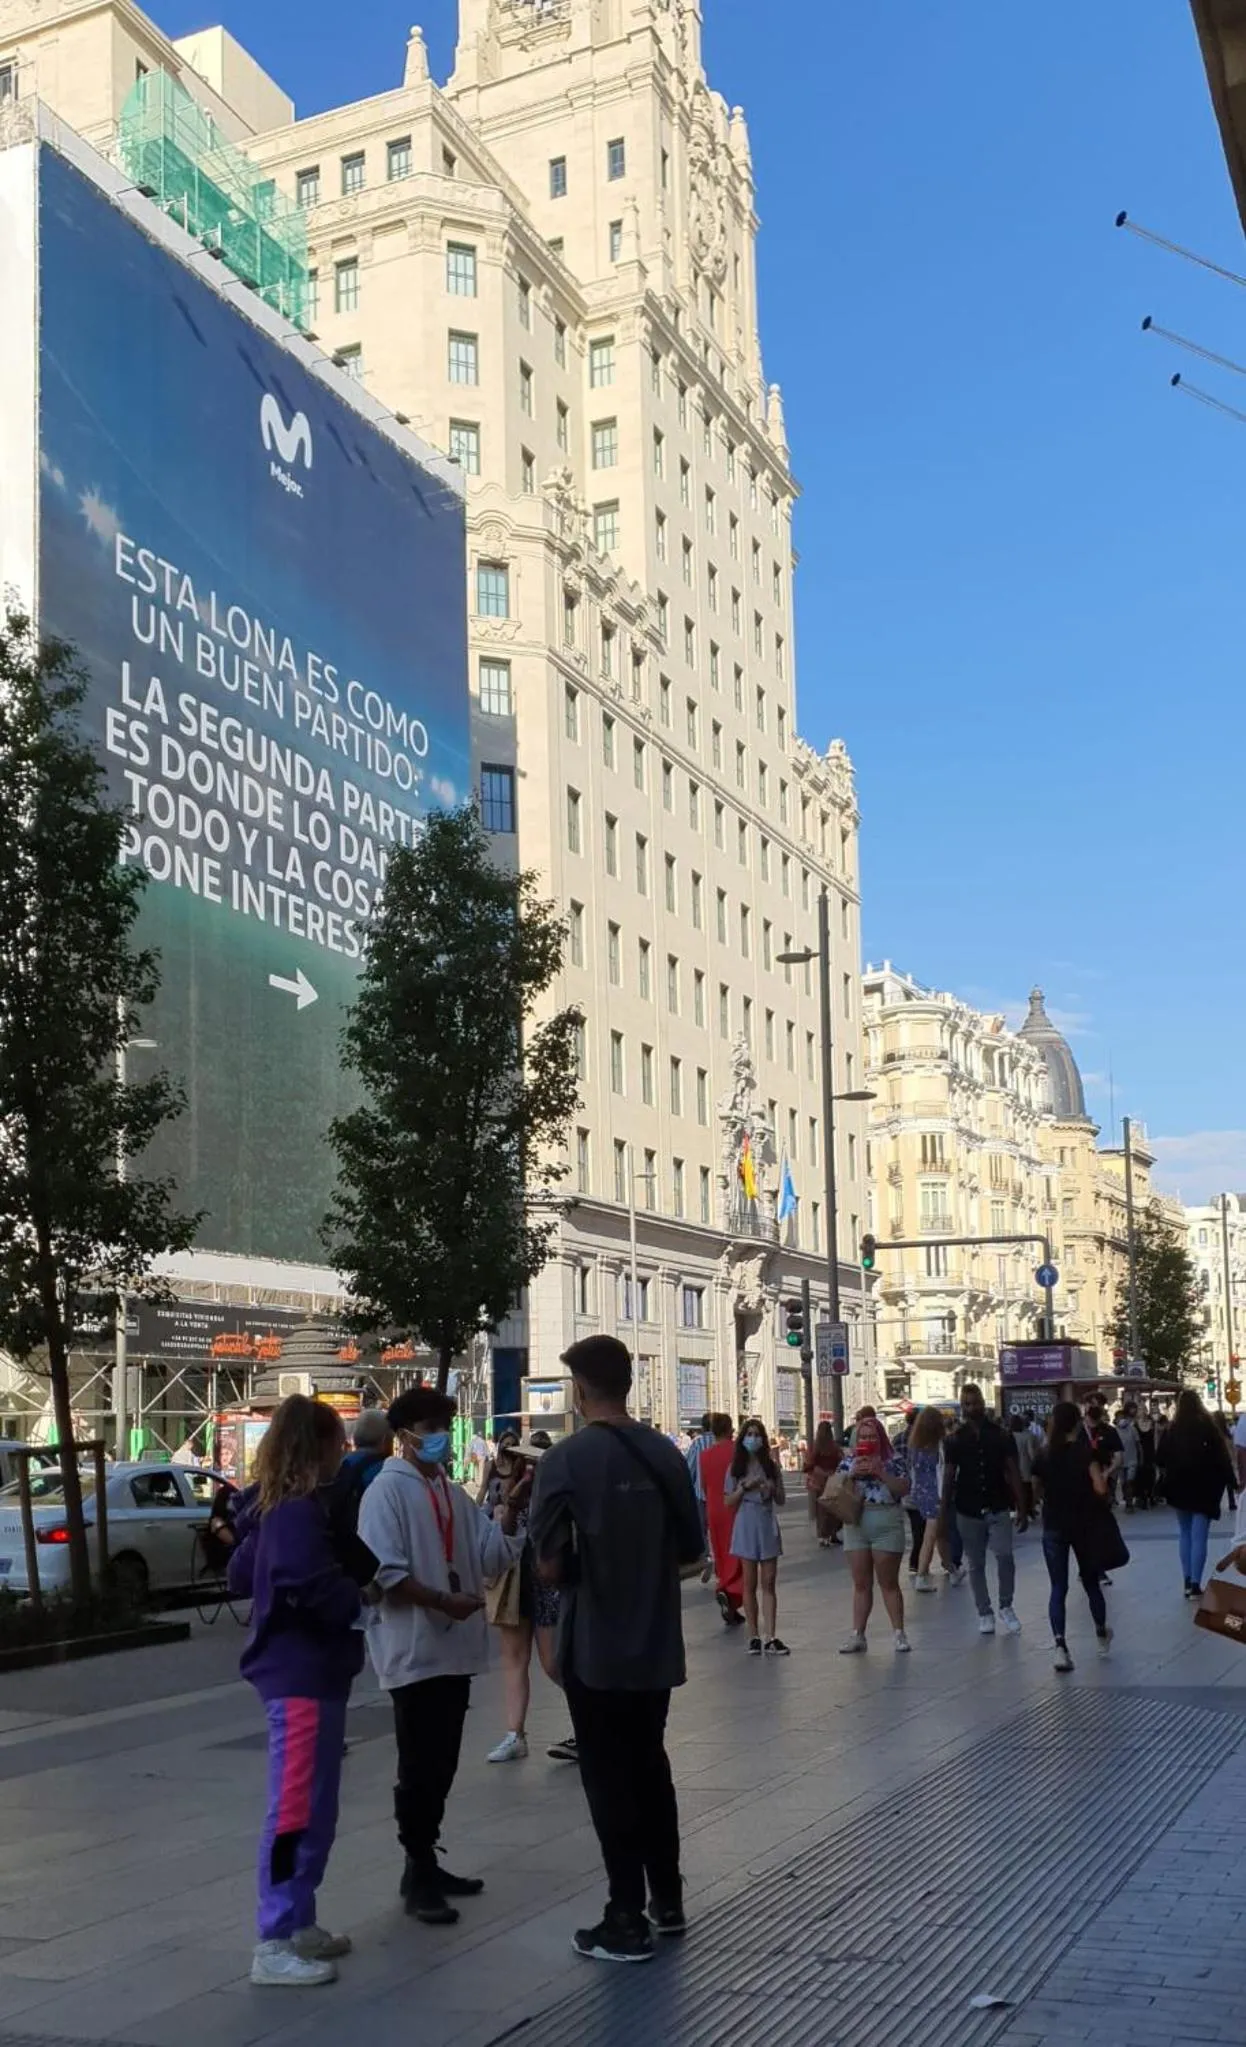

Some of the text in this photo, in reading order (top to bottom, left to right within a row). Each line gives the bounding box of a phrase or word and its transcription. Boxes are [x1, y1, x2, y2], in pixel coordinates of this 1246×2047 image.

[270, 461, 304, 499] Mejor.
[115, 533, 428, 758] ESTA LONA ES COMO
[132, 596, 420, 797] UN BUEN PARTIDO:
[106, 707, 150, 766] ES
[162, 734, 285, 832] DONDE
[294, 802, 332, 852] LO
[122, 662, 427, 849] LA SEGUNDA PARTE
[118, 824, 222, 903] PONE
[124, 769, 230, 854] TODO
[238, 821, 259, 866] Y
[267, 837, 305, 889] LA
